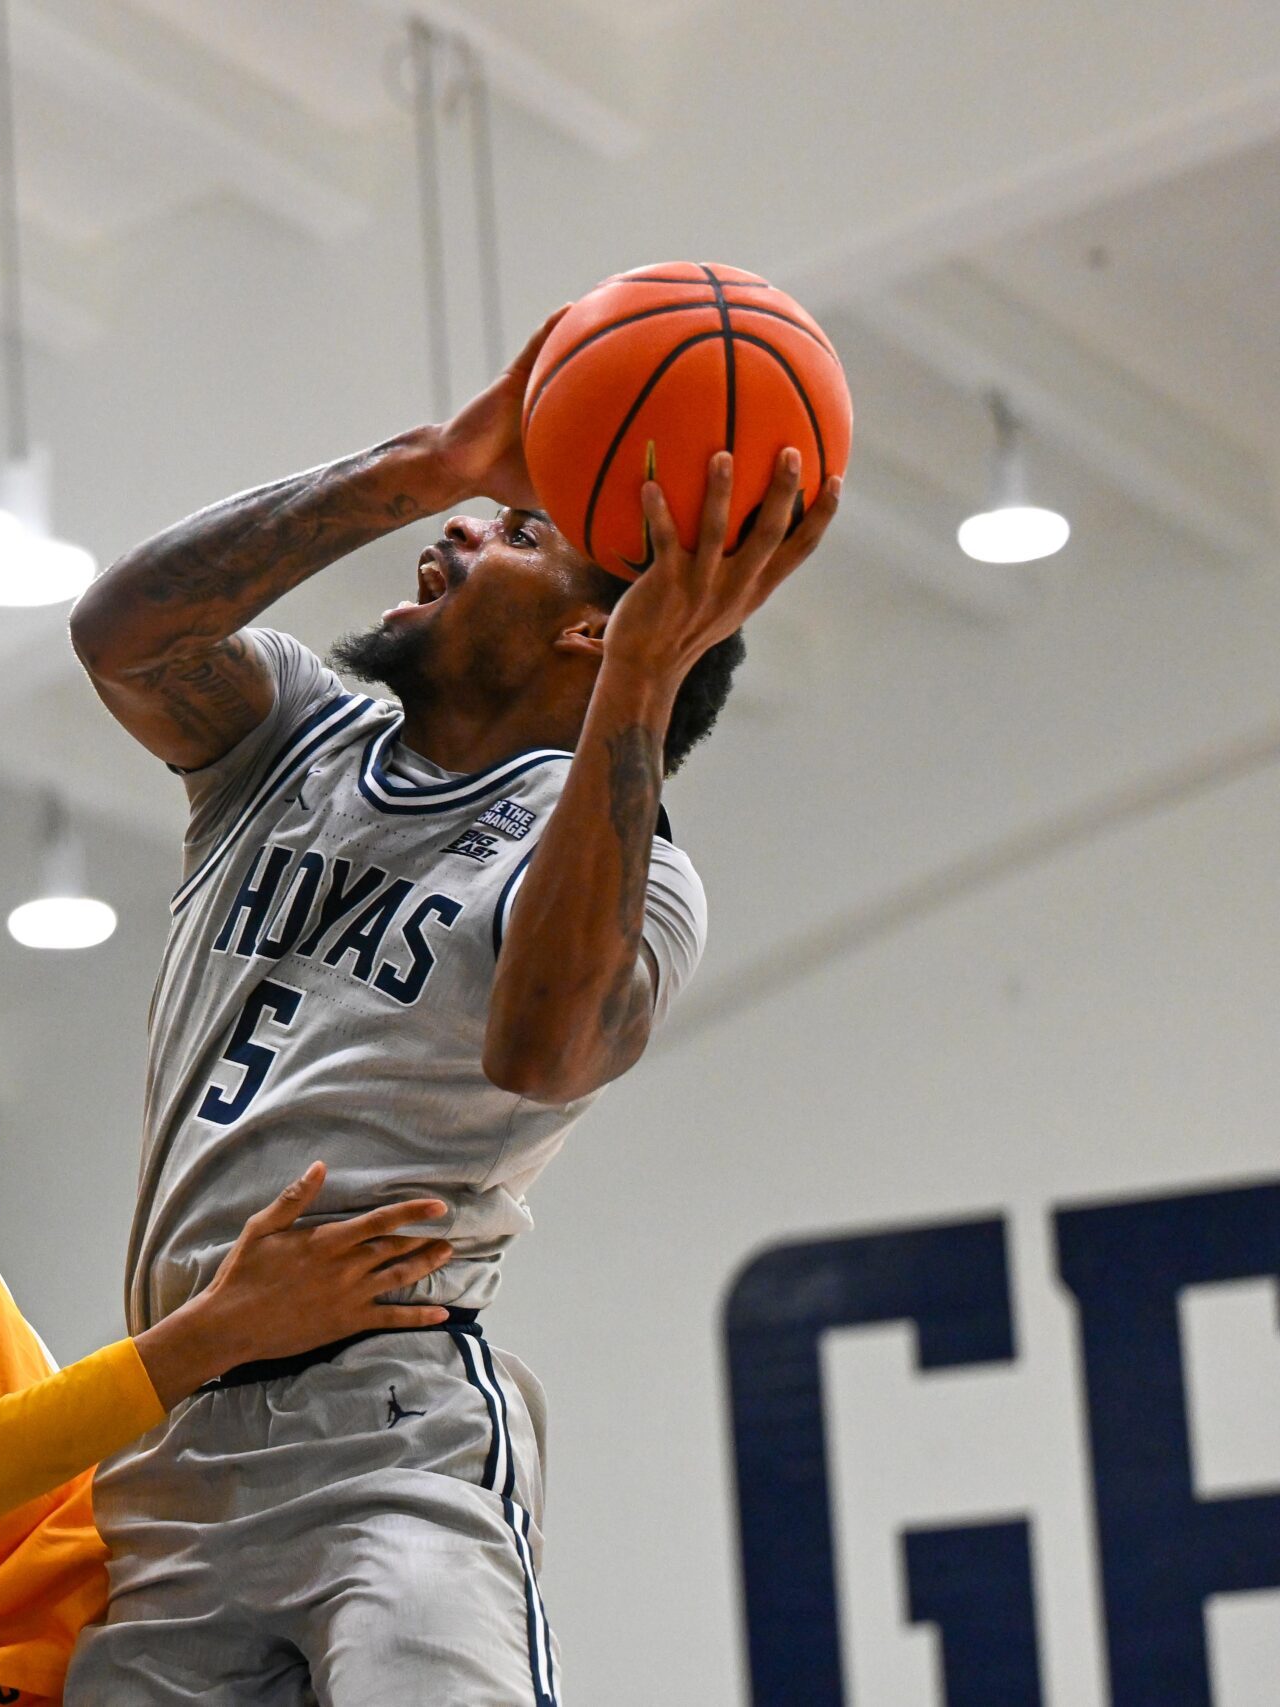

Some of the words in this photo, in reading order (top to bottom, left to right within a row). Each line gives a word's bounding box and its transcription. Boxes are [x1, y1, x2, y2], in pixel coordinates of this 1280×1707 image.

[477, 810, 528, 840] CHANGE
[505, 804, 535, 827] THE
[448, 838, 499, 859] EAST
[459, 829, 499, 847] BIG
[211, 844, 465, 1008] HOYAS
[194, 976, 307, 1127] 5
